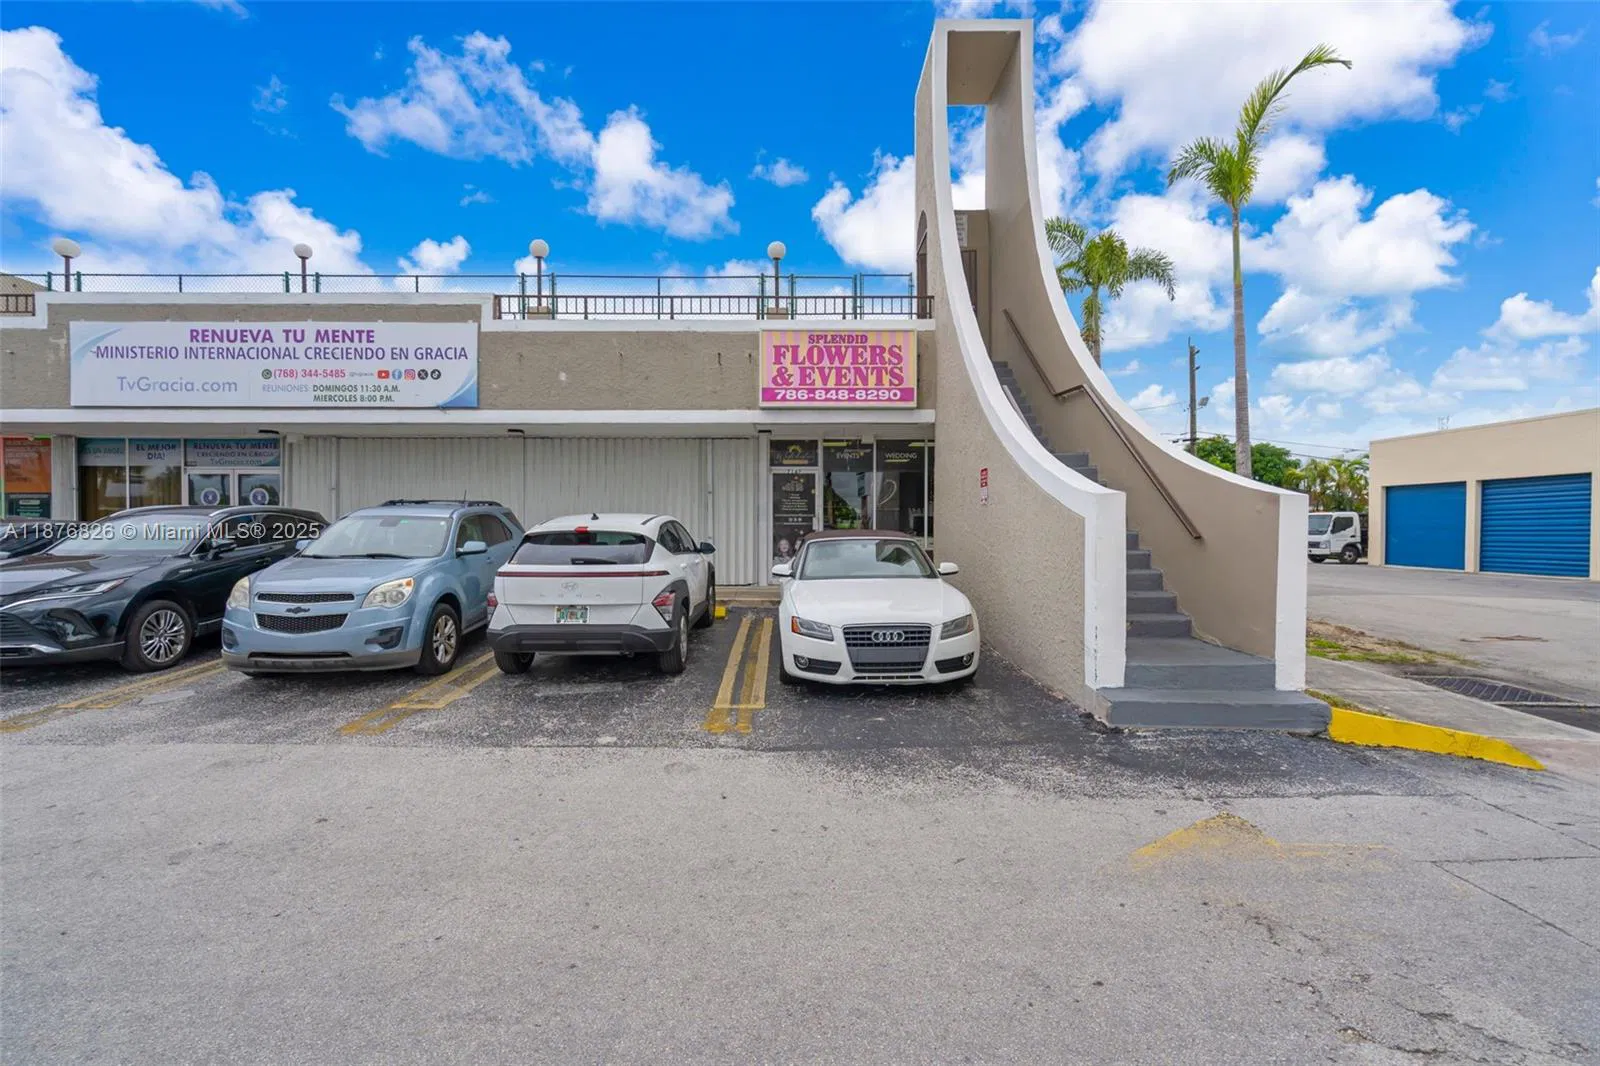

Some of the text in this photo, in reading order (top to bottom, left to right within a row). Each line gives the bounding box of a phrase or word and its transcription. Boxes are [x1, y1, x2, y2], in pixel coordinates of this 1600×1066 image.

[189, 328, 375, 344] RENUEVA TU MENTE
[808, 334, 868, 344] SPLENDID
[95, 345, 468, 360] MINISTERIO INTERNACIONAL CRECIENDO EN GRACIA
[772, 344, 904, 365] FLOWERS
[273, 369, 298, 379] (768)
[301, 369, 346, 378] 344-5485
[771, 366, 905, 387] & EVENTS
[116, 376, 238, 393] TvGracia.com
[312, 384, 358, 392] DOMINGOS
[360, 384, 381, 392] 11:30
[383, 384, 401, 393] A.M.
[312, 394, 358, 403] MIERCOLES
[379, 394, 396, 403] P.M.
[774, 389, 901, 400] 786-848-8290
